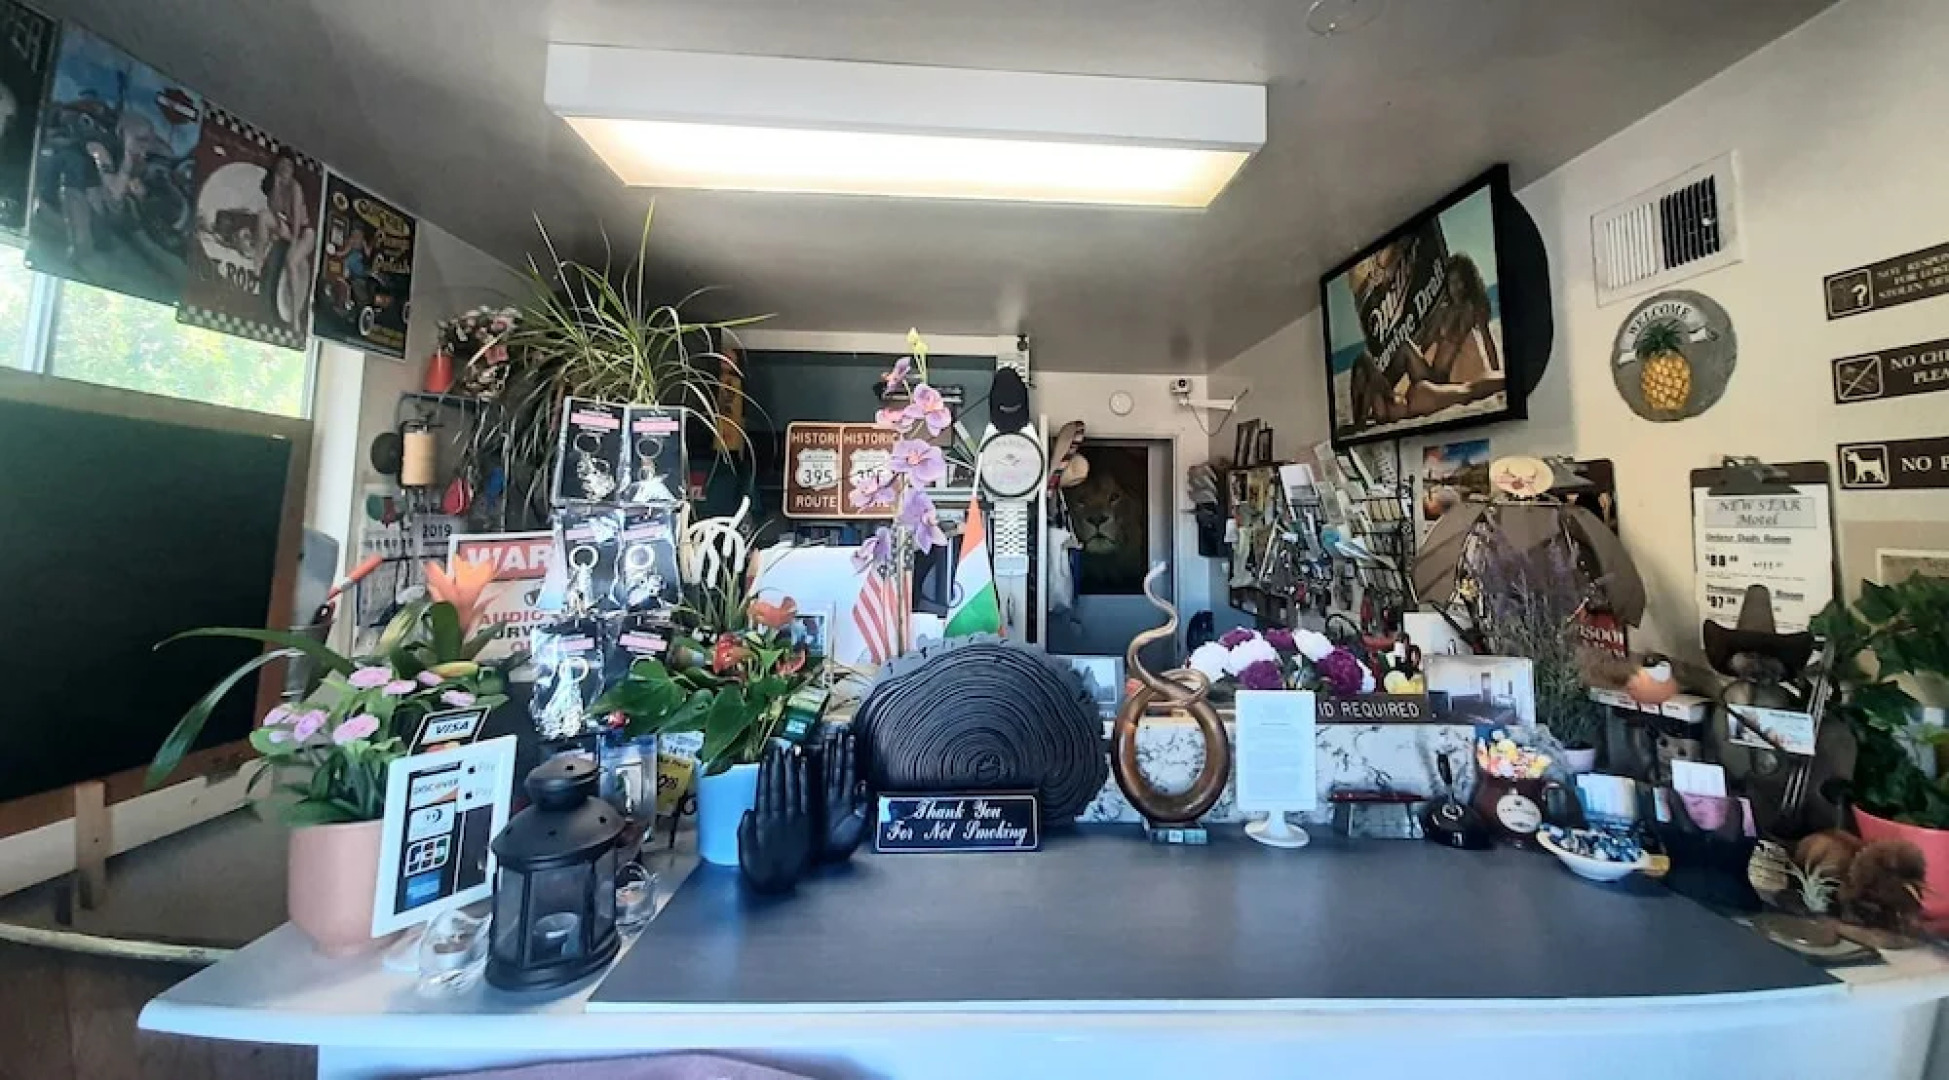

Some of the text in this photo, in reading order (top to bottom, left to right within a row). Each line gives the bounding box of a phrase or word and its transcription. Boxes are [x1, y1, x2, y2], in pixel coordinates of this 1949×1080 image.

[1628, 303, 1693, 335] WELCOME
[1890, 354, 1916, 371] NO
[1901, 455, 1932, 472] NO
[803, 469, 833, 484] 395
[796, 495, 837, 508] ROUTE
[423, 523, 452, 538] 2019
[1318, 702, 1420, 718] ID REQUIRED
[903, 800, 1003, 819] Thank You
[886, 820, 1028, 847] For Not Smoking
